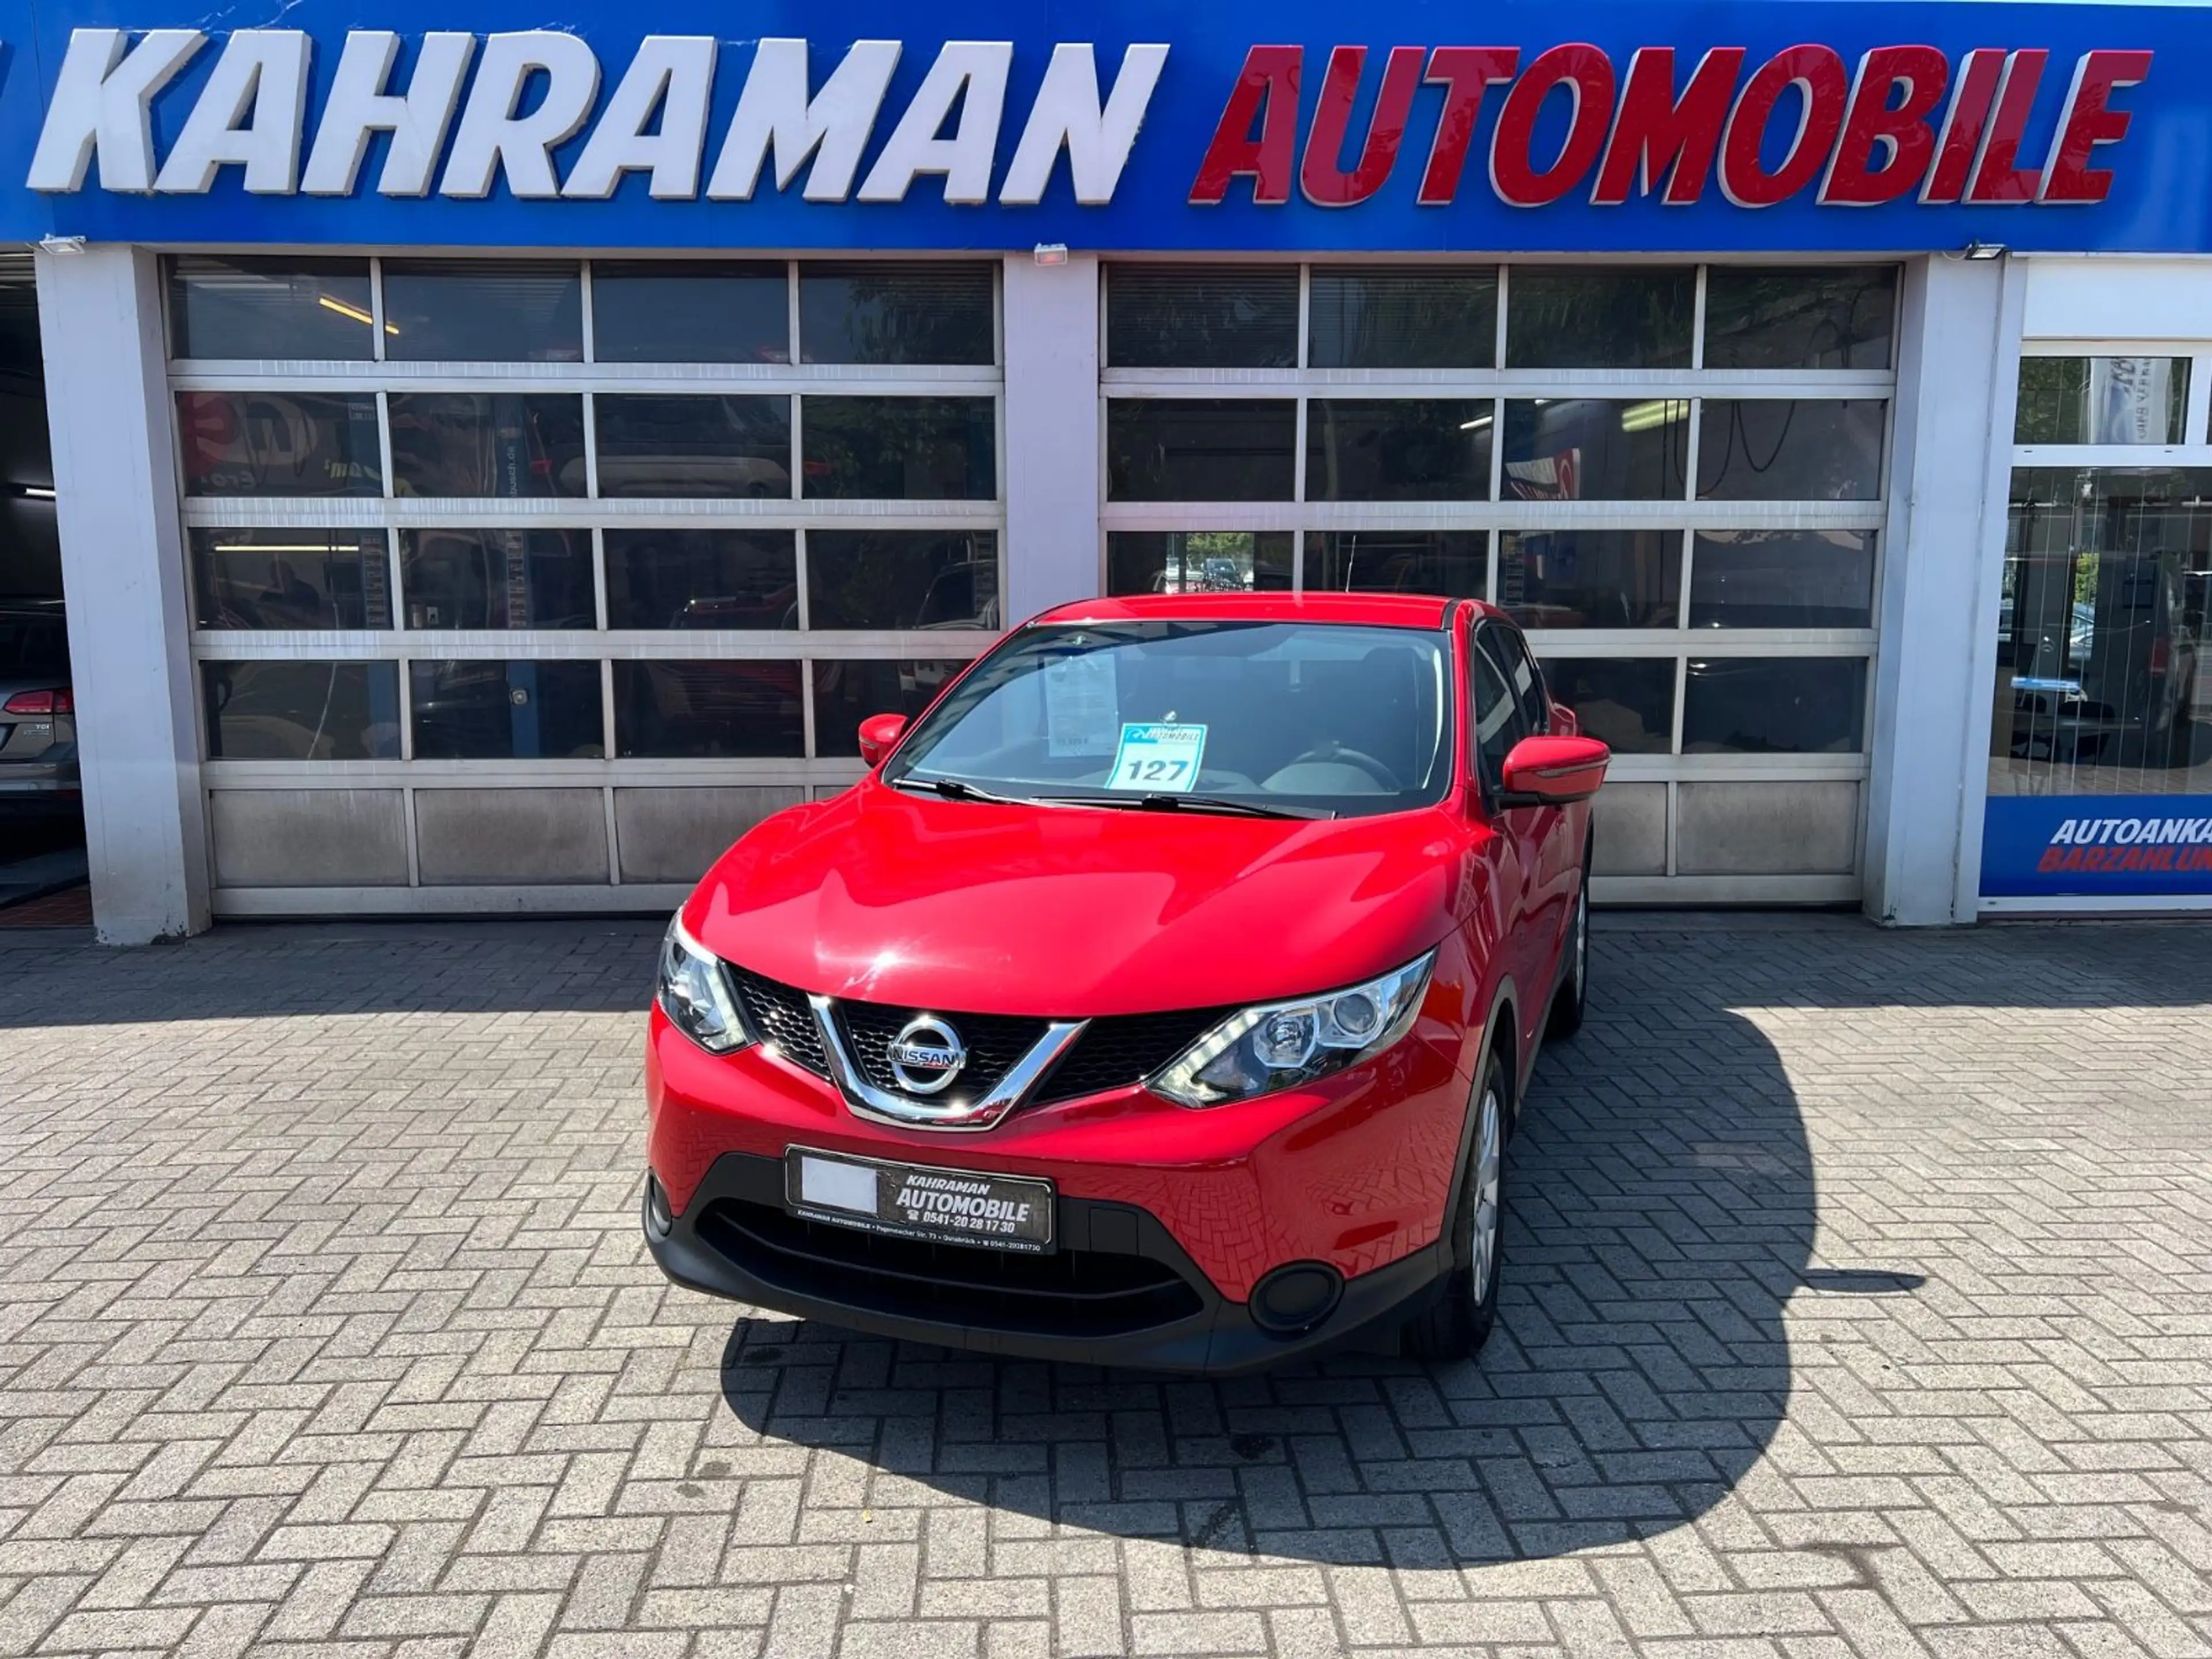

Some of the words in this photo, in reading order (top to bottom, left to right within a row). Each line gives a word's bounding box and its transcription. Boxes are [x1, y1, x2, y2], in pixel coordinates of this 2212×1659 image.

[26, 28, 1171, 206] KAHRAMAN
[1188, 43, 2154, 208] AUTOMOBILE
[1128, 760, 1190, 782] 127
[891, 1048, 955, 1066] NISSAN
[906, 1175, 991, 1196] KAHRAMAN
[896, 1187, 1031, 1222] AUTOMOBILE
[923, 1210, 968, 1228] 0541-20
[969, 1217, 984, 1230] 28
[985, 1219, 999, 1232] 17
[999, 1221, 1016, 1234] 30
